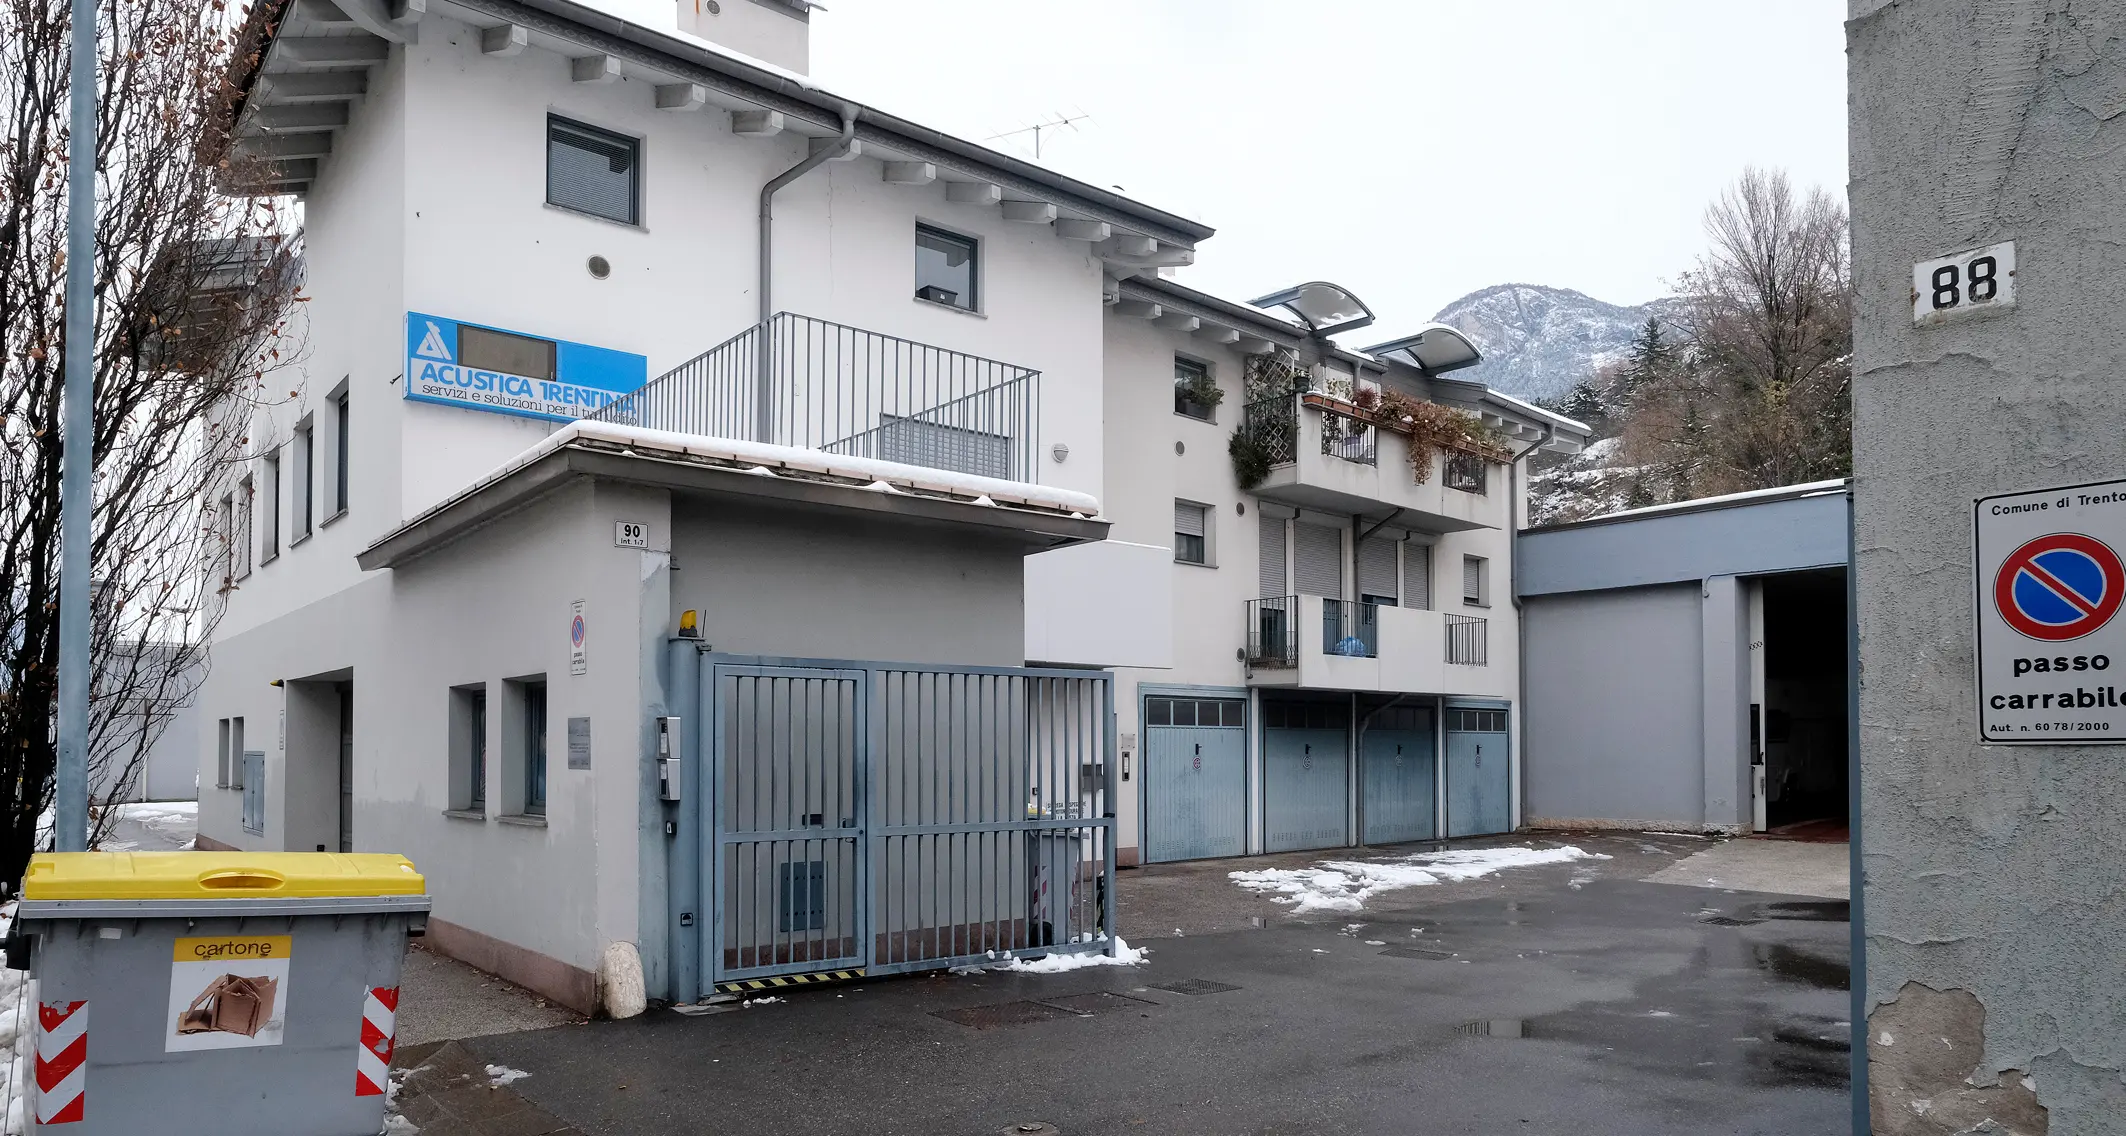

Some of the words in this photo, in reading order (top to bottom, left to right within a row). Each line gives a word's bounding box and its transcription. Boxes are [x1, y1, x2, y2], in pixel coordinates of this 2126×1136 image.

[1932, 255, 1997, 310] 88
[421, 362, 533, 398] ACUSTICA
[539, 381, 636, 415] TRENTINA
[422, 384, 468, 400] servizi
[472, 392, 481, 402] e
[484, 394, 542, 411] soluzioni
[547, 403, 567, 415] per
[571, 405, 578, 417] il
[1991, 502, 2048, 516] Comune
[2056, 497, 2070, 508] di
[2078, 491, 2126, 506] Trento
[624, 524, 640, 538] 90
[2013, 654, 2110, 677] passo
[1990, 724, 2014, 732] Aut.
[194, 941, 272, 956] cartone
